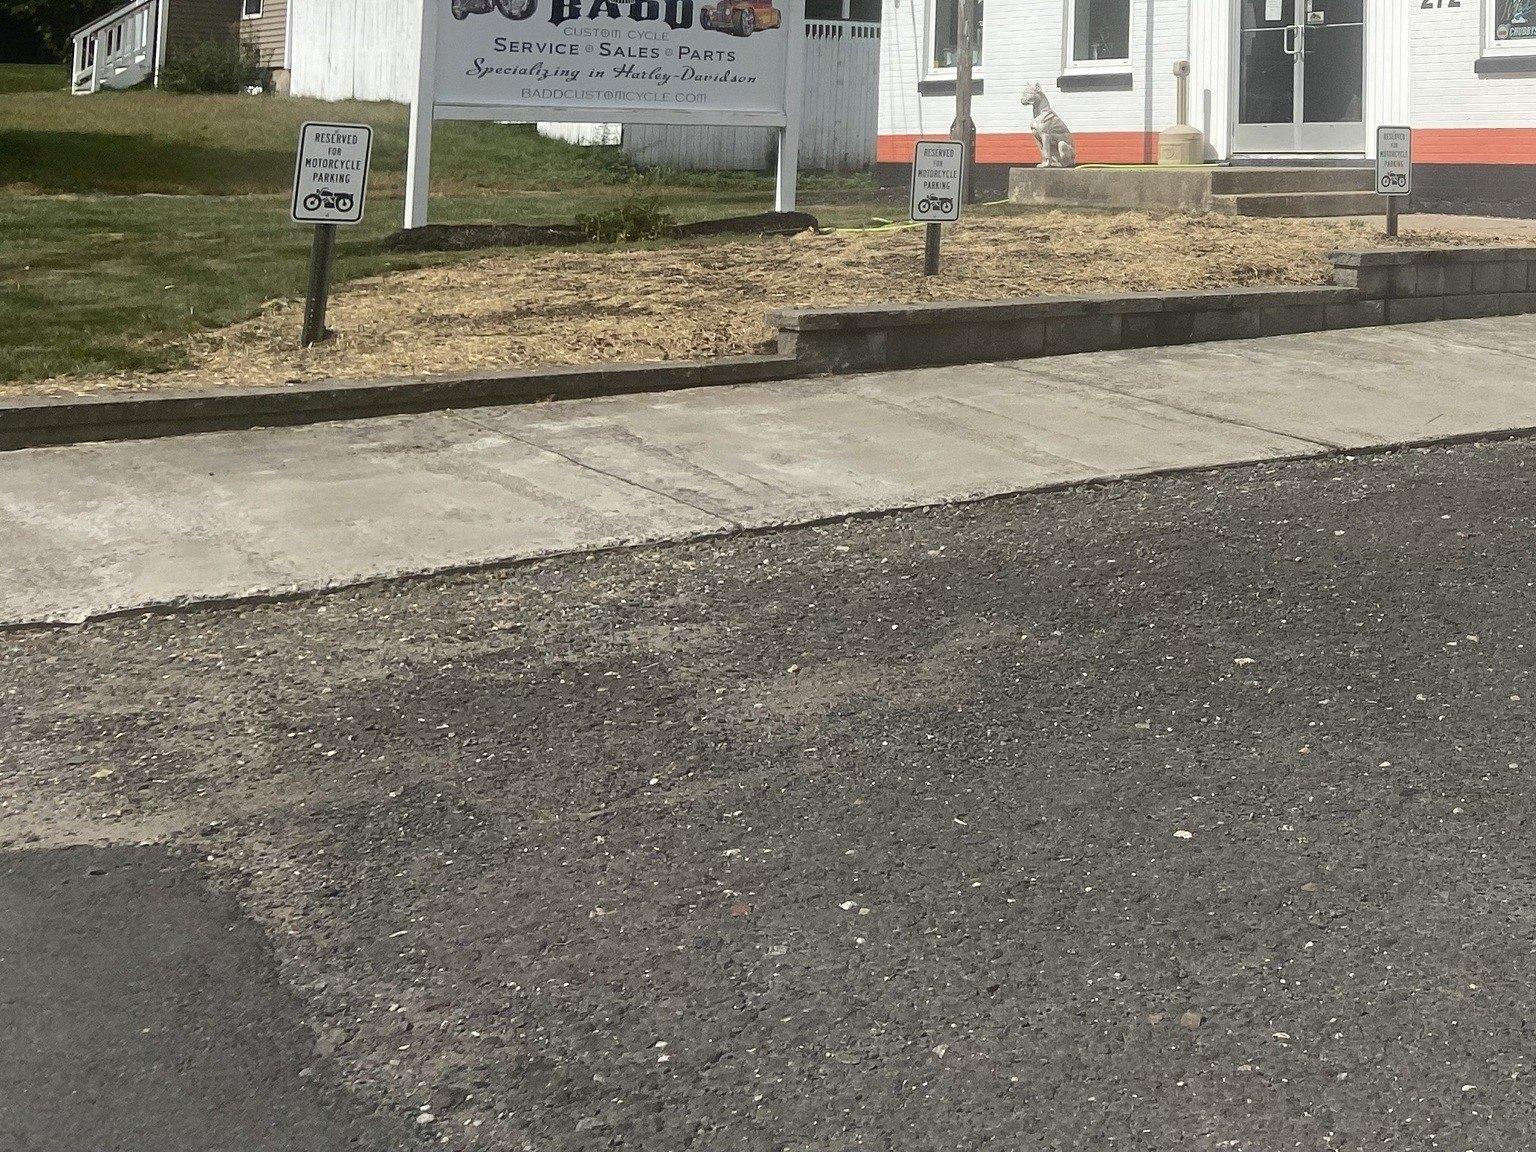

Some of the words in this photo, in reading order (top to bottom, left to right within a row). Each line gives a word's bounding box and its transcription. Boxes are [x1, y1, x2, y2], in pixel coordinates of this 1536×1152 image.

[563, 26, 621, 39] CUSTOM
[627, 30, 670, 42] CYCLE
[466, 57, 581, 83] Specializing
[588, 67, 605, 78] in
[613, 63, 757, 86] Harley-Davidson
[315, 133, 358, 145] RESERVED
[328, 147, 341, 156] FOR
[923, 148, 954, 158] RESERVED
[304, 158, 361, 170] MOTORCYCLE
[312, 172, 351, 184] PARKING
[918, 170, 957, 178] MOTORCYCLE
